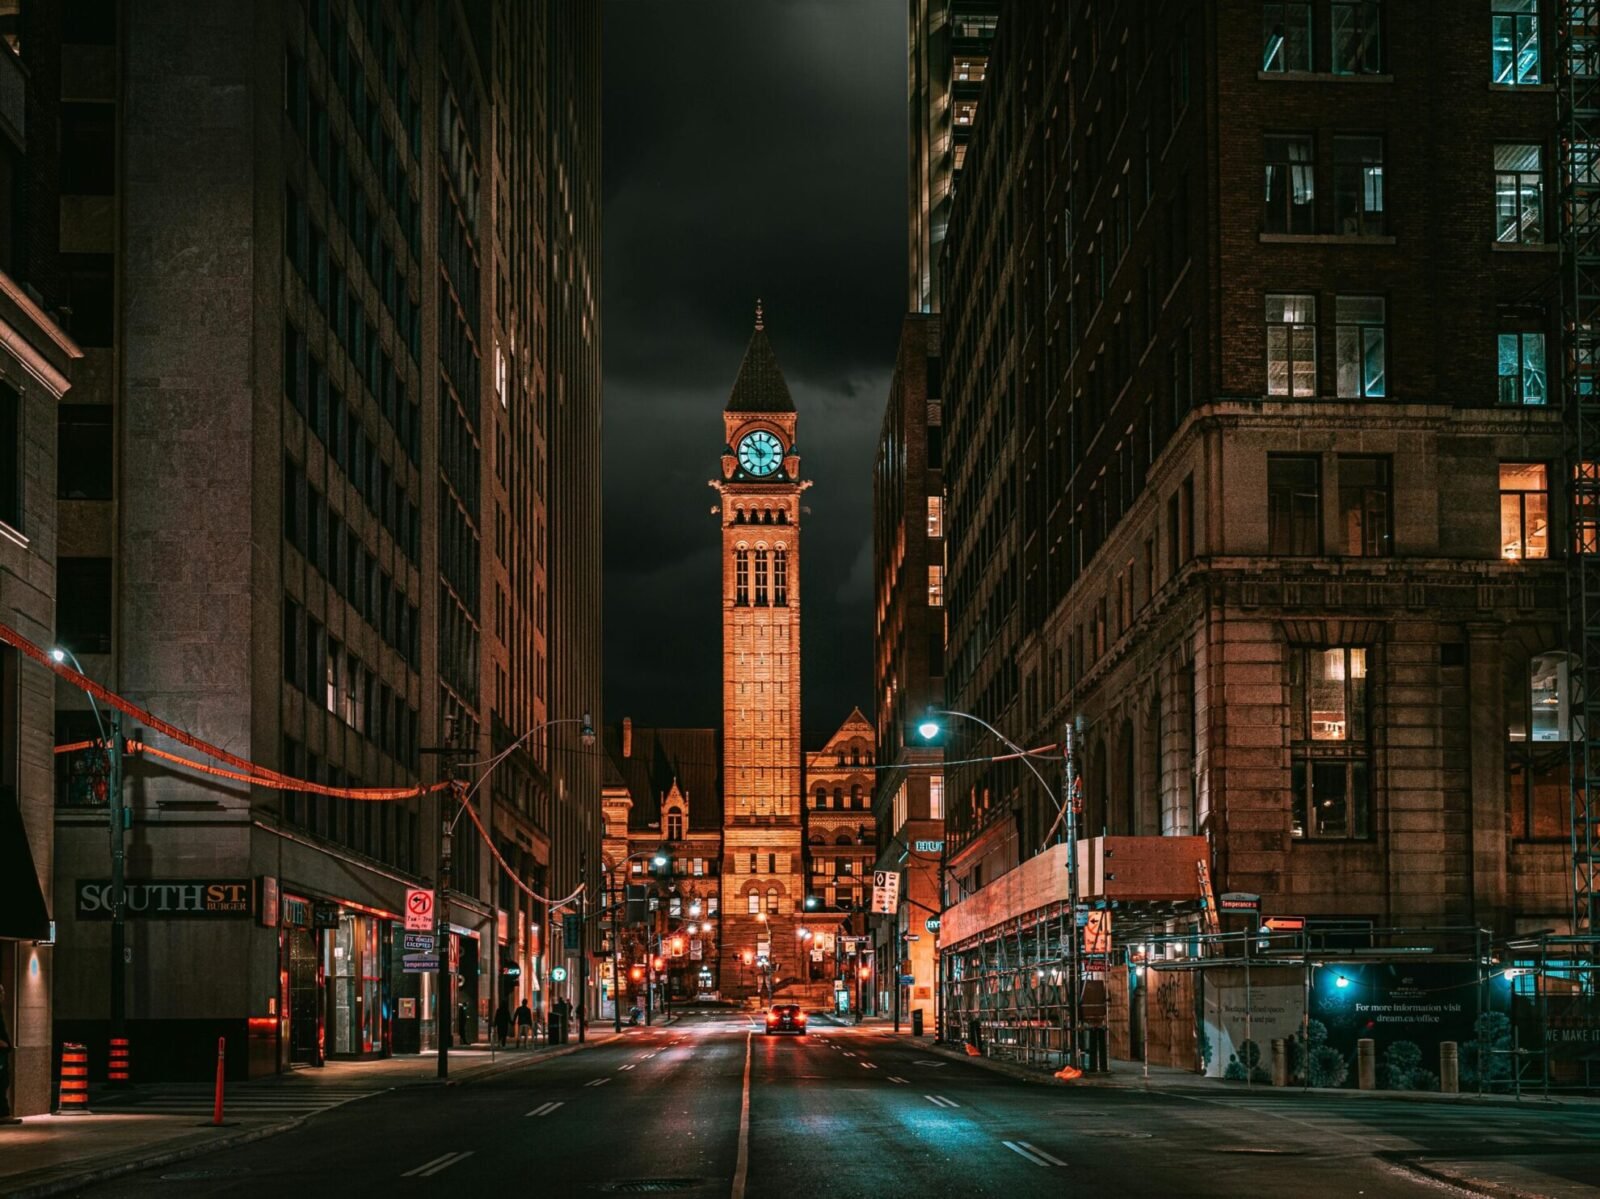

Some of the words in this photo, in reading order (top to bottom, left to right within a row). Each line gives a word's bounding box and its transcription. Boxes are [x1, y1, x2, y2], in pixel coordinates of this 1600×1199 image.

[80, 885, 204, 911] SOUTH
[207, 885, 247, 902] ST.
[207, 902, 246, 911] BURGER
[1222, 900, 1251, 908] Temperance
[404, 961, 433, 969] Temperance
[1355, 1003, 1368, 1011] For
[1393, 1003, 1442, 1012] information
[1444, 1003, 1461, 1012] visit
[1376, 1015, 1440, 1023] dream.ca/office
[1562, 1030, 1587, 1041] MAKE
